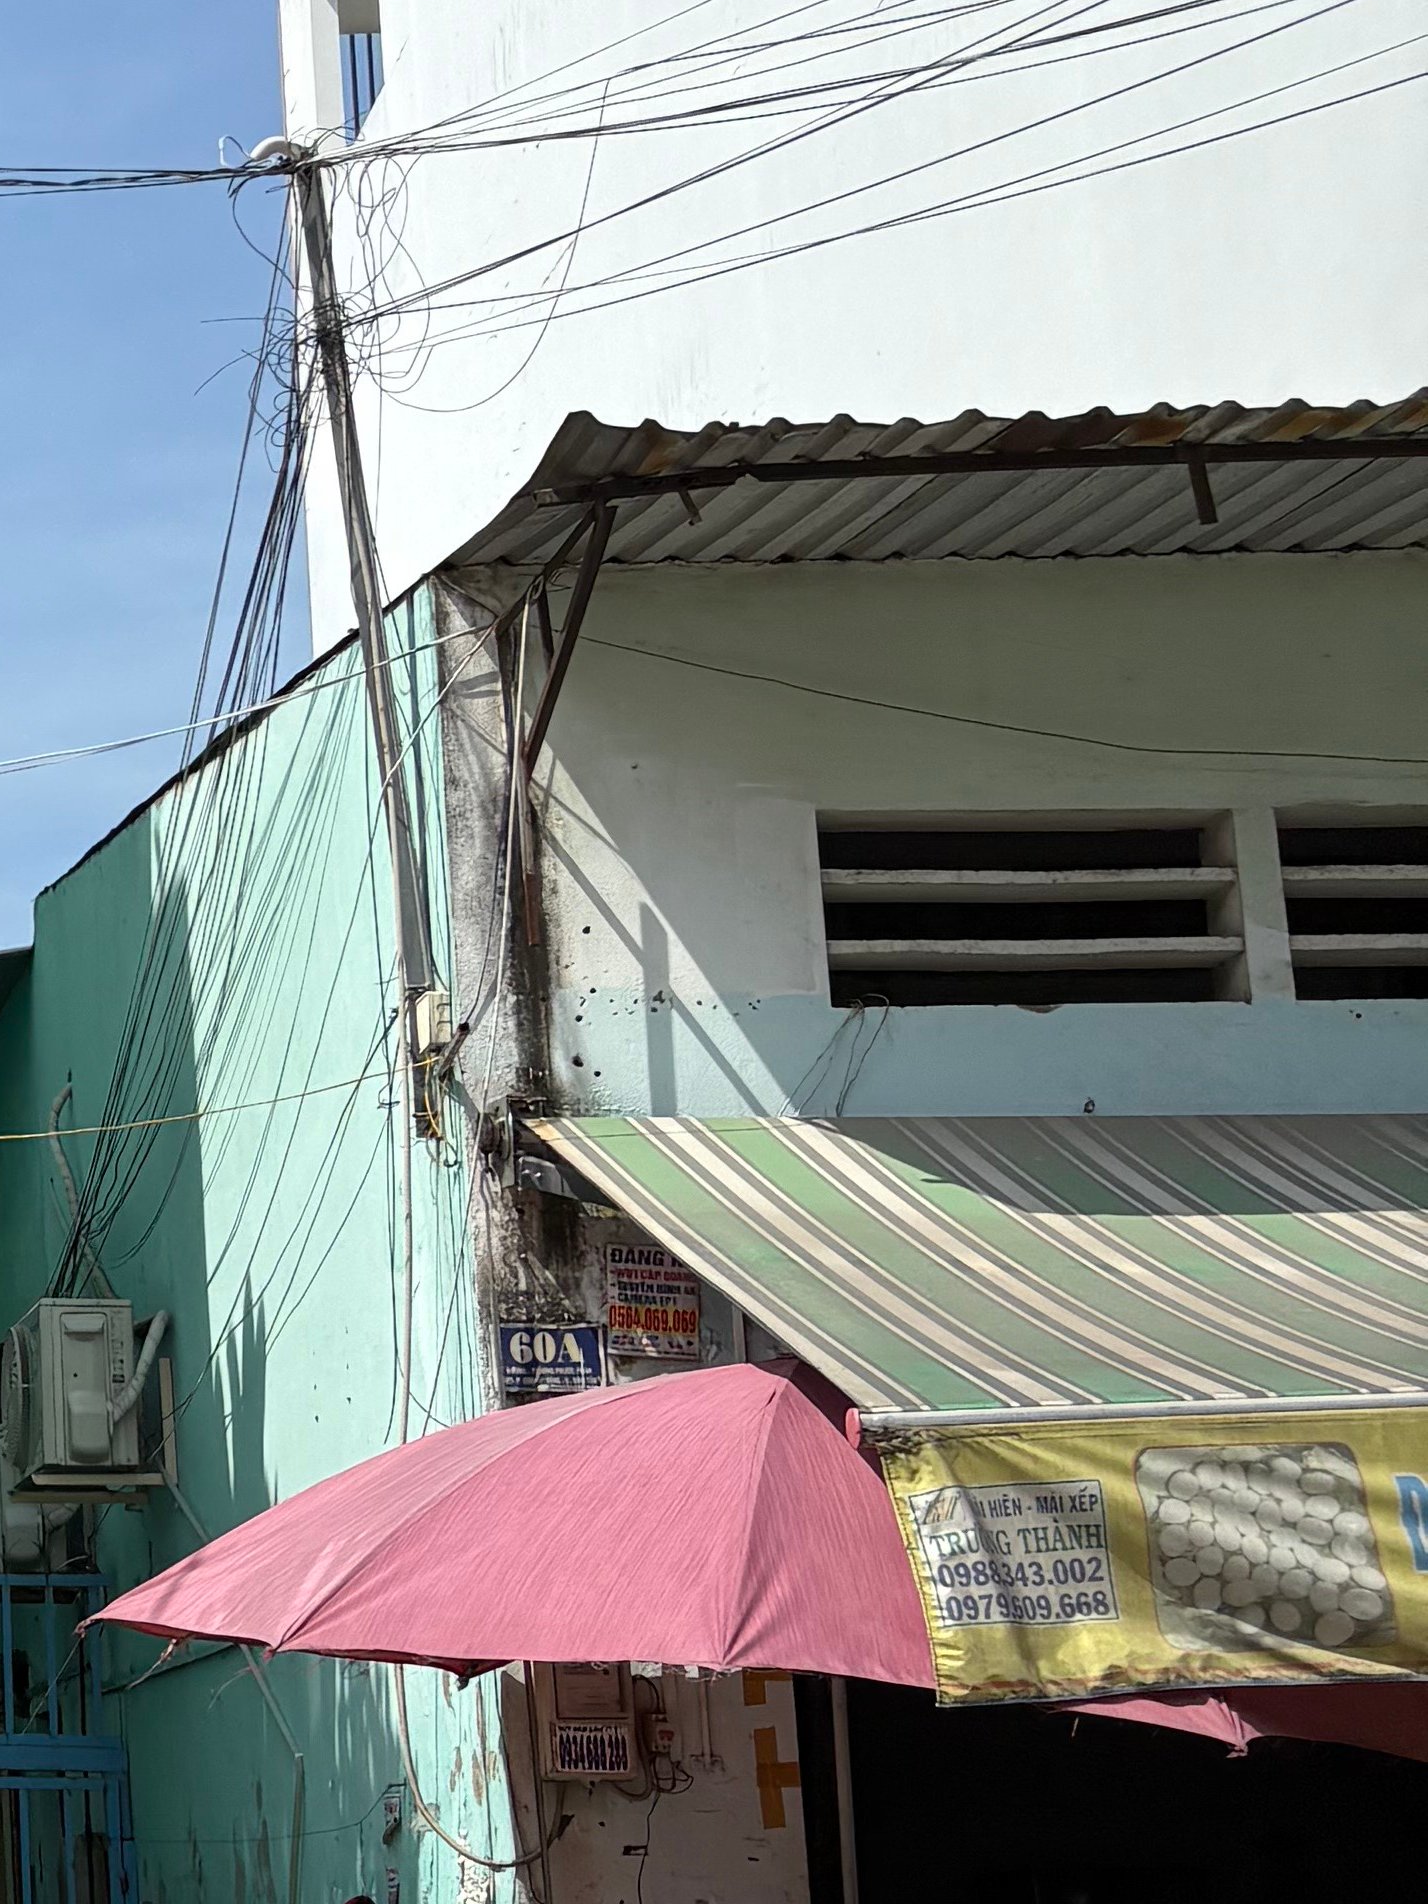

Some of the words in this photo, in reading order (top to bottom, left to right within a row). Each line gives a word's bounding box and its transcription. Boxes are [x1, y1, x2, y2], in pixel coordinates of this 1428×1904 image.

[510, 1331, 583, 1364] 60A
[1069, 1486, 1099, 1513] XẾP
[1017, 1519, 1104, 1555] THÀNH
